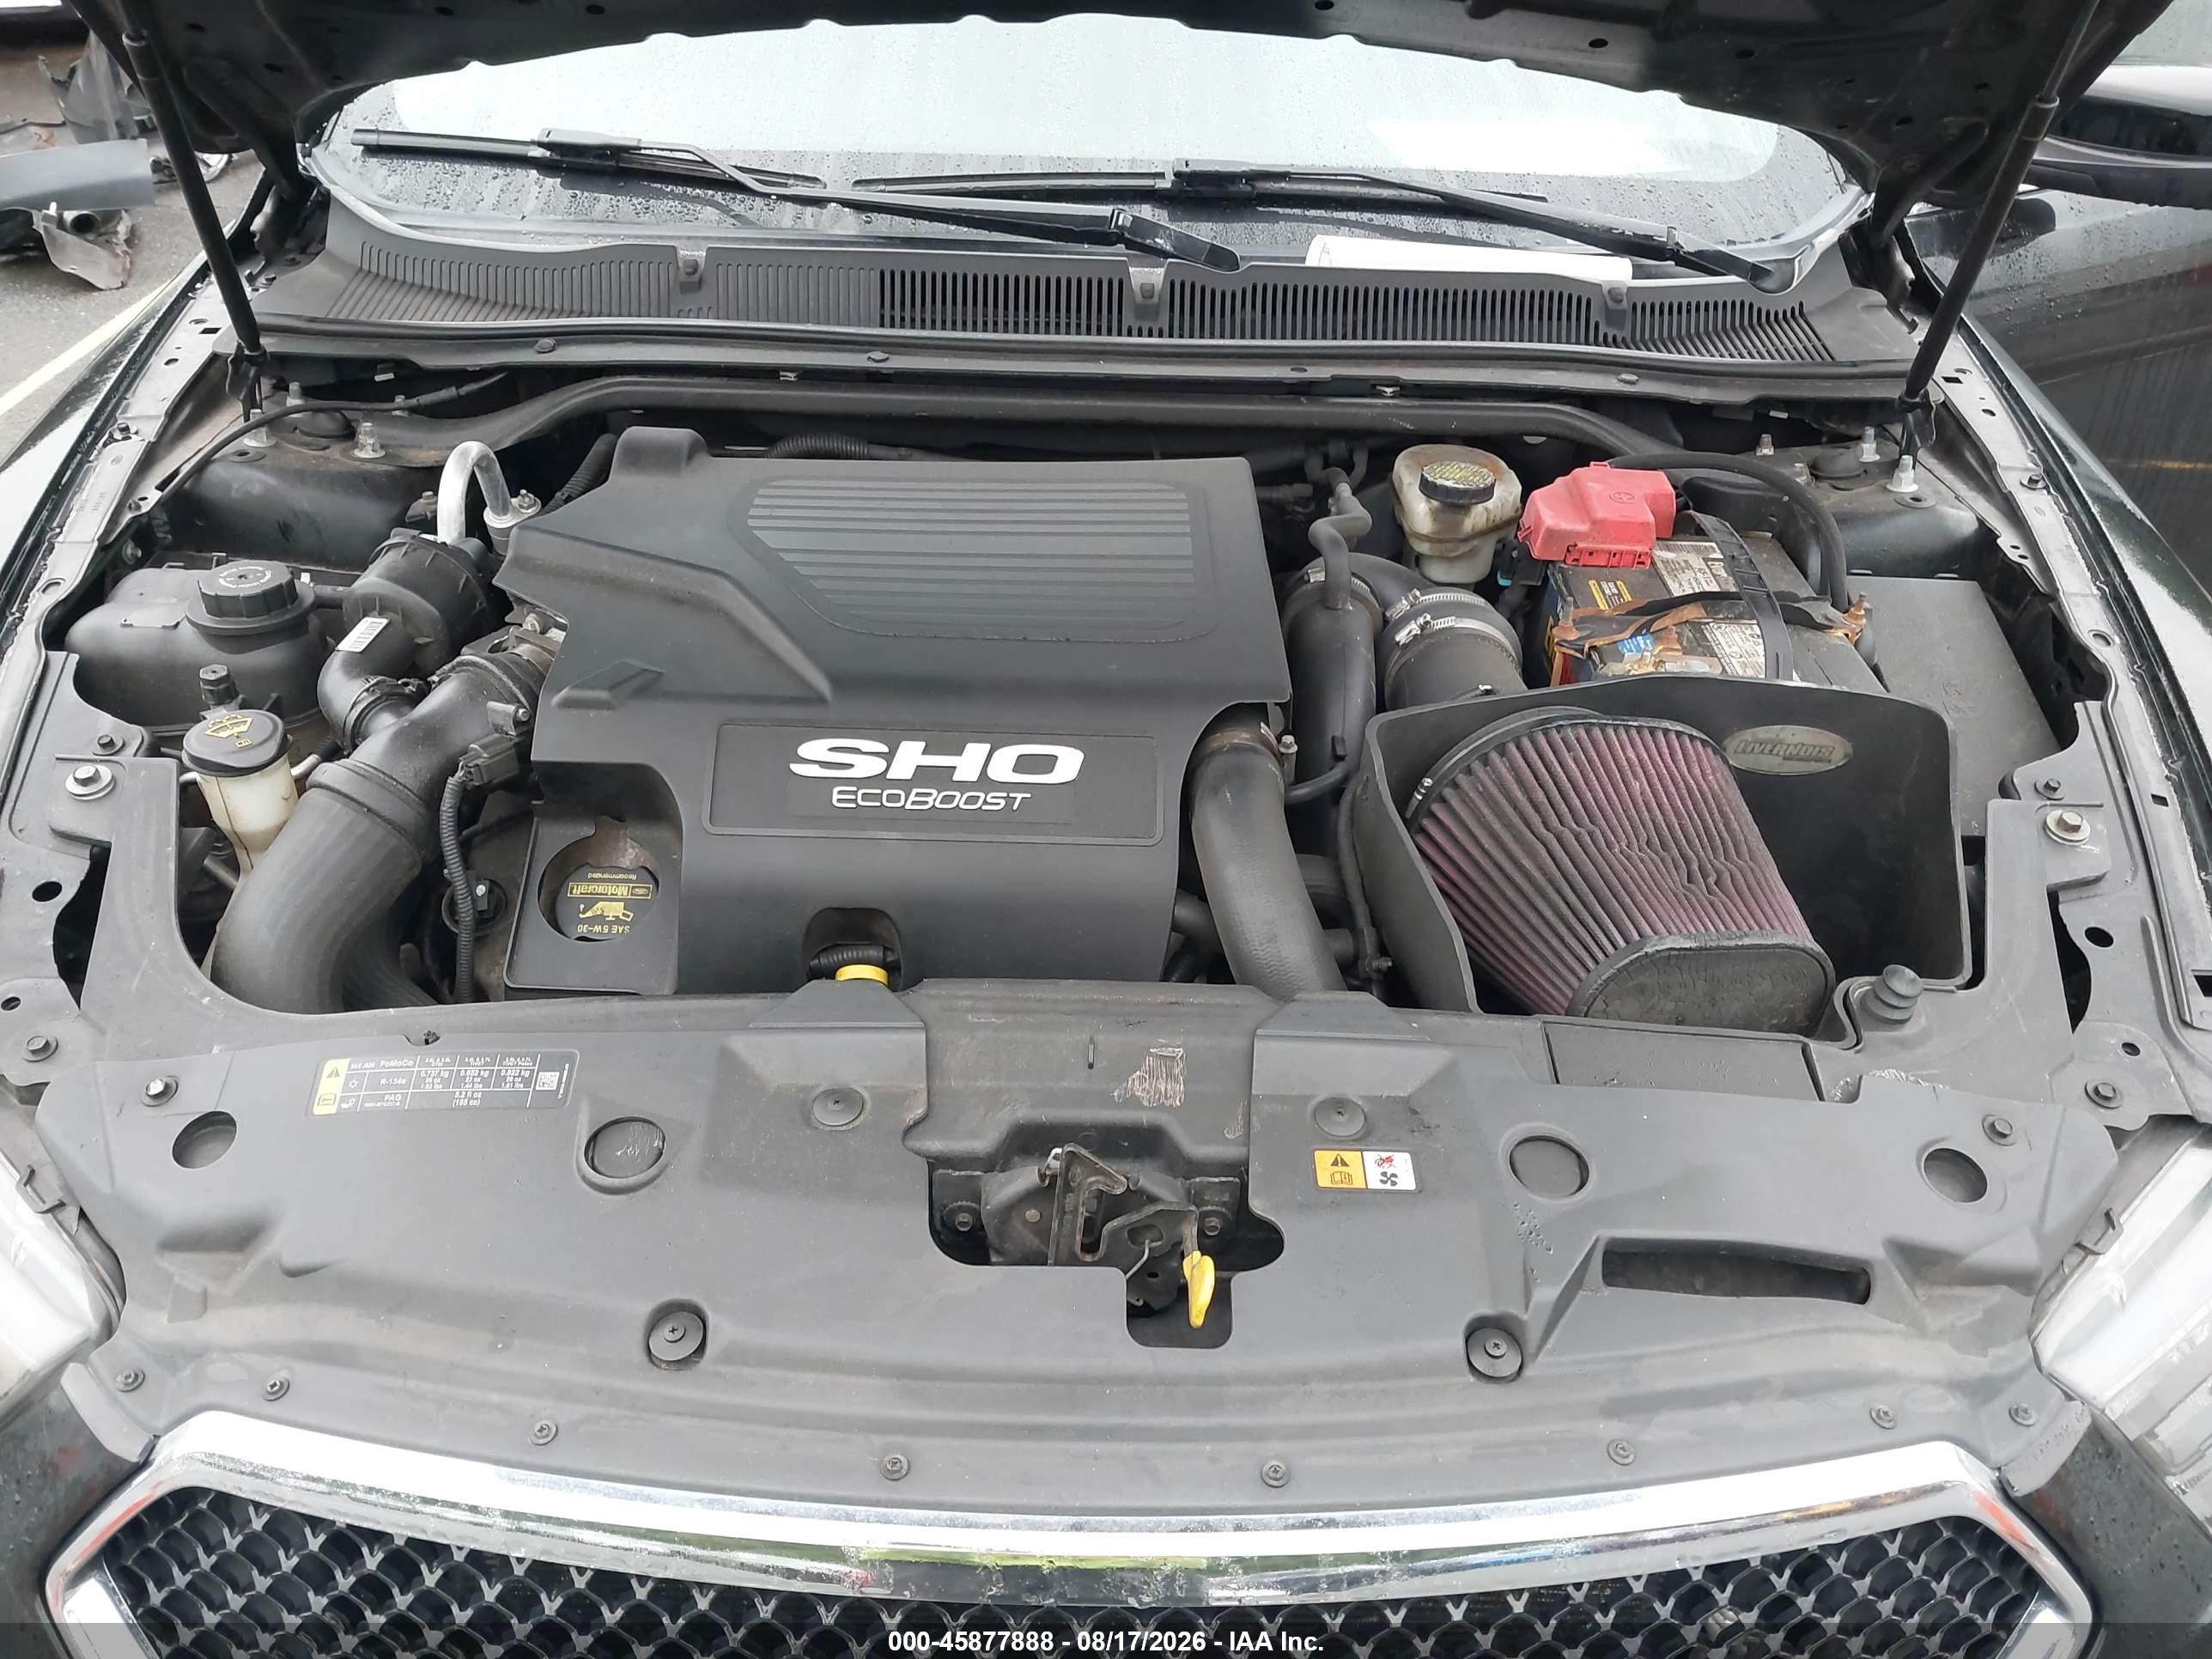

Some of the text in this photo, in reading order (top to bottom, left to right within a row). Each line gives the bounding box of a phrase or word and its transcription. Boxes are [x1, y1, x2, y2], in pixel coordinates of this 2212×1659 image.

[1734, 738, 1836, 757] LIVERNOIS
[788, 738, 1085, 785] SHO
[587, 872, 637, 881] Recommended
[572, 884, 629, 896] Motorcraft
[577, 924, 631, 934] SAE 5W-30
[379, 1059, 414, 1068] FoMoCo
[440, 1070, 450, 1079] kg
[520, 1069, 531, 1078] kg
[380, 1078, 406, 1086] R-134a
[469, 1098, 481, 1107] cc)
